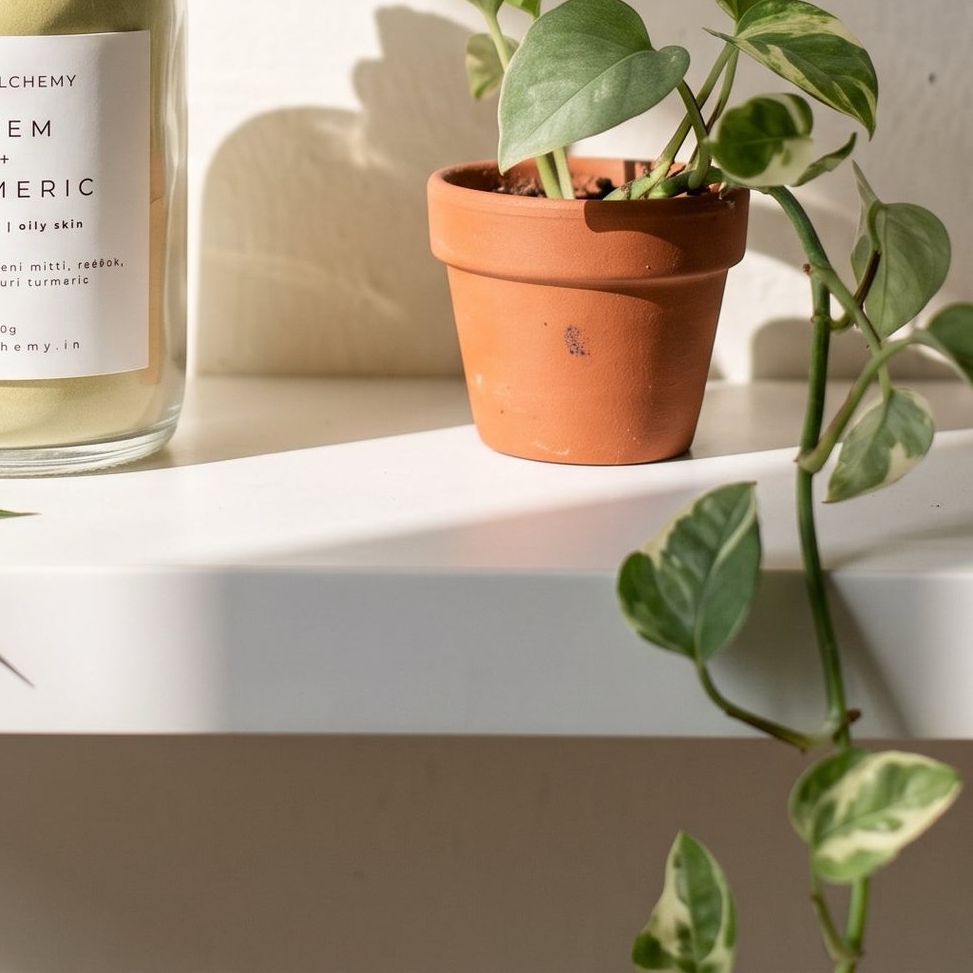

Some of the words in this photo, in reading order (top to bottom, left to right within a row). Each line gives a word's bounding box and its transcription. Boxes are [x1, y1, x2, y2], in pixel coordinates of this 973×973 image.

[0, 154, 10, 165] +
[18, 219, 47, 233] oily
[53, 218, 84, 230] skin
